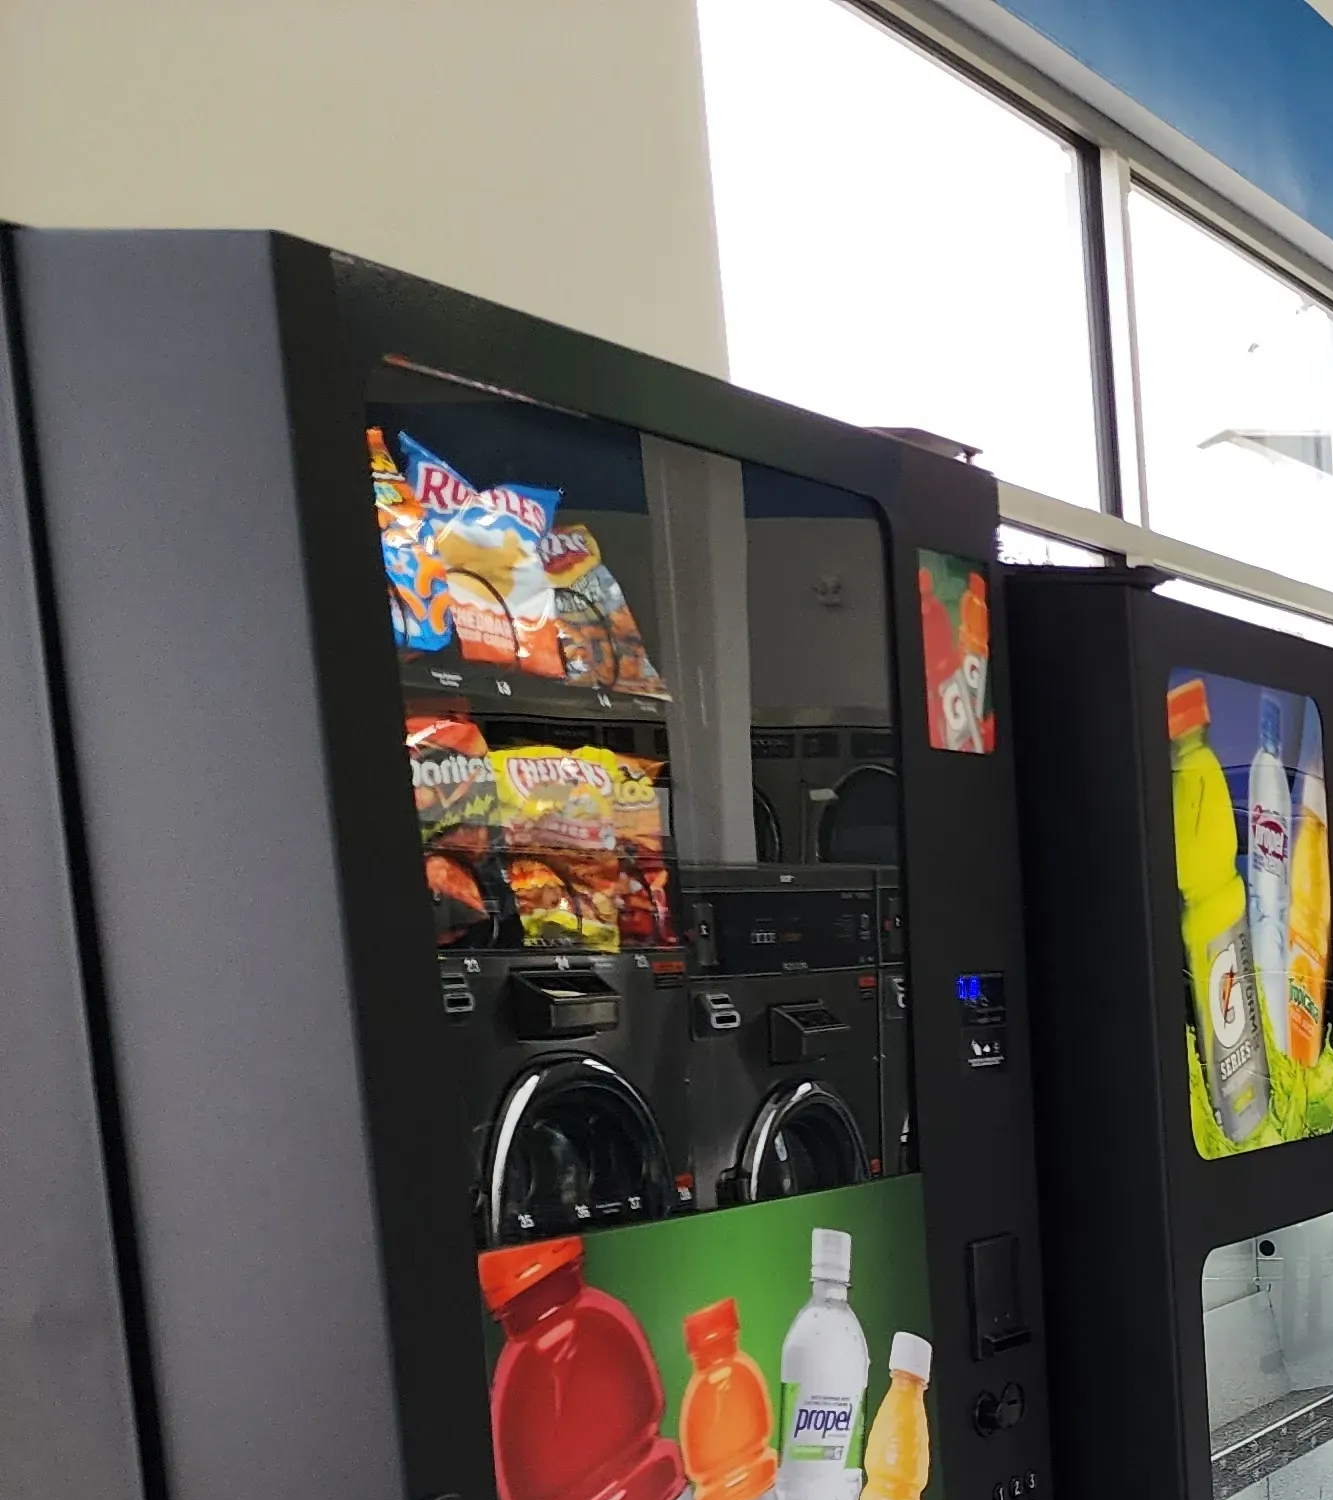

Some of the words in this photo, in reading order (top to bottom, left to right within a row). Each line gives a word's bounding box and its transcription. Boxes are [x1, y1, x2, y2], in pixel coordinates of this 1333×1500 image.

[1208, 942, 1246, 1048] G
[1220, 1040, 1252, 1081] SERIES
[794, 1403, 852, 1439] propel
